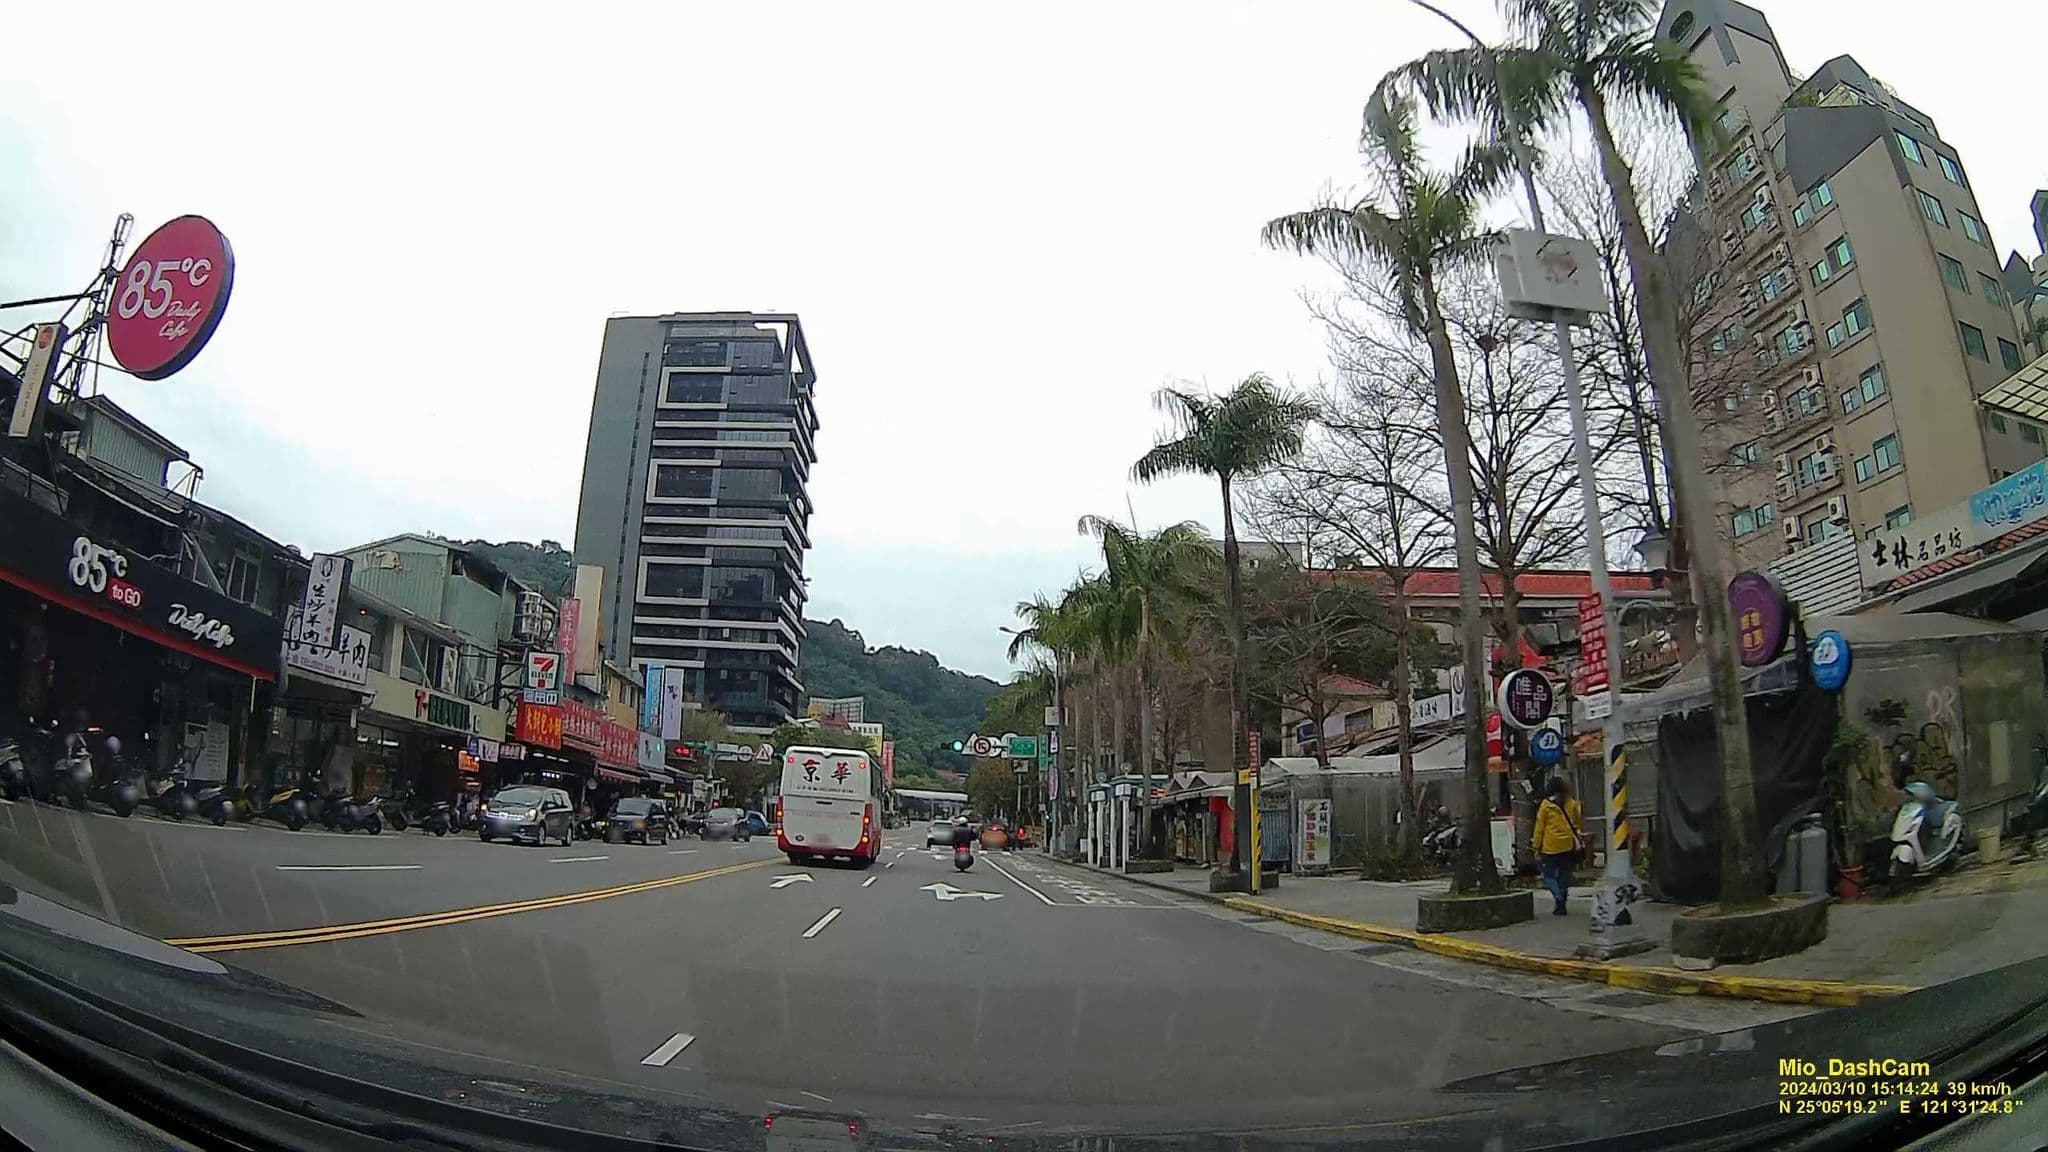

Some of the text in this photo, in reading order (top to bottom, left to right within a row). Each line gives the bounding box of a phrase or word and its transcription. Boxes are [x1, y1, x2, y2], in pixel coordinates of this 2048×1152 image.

[1872, 526, 1963, 570] 士林名品坊
[111, 584, 142, 607] to GO
[303, 583, 326, 643] 生炒羊肉
[802, 759, 852, 785] 京華
